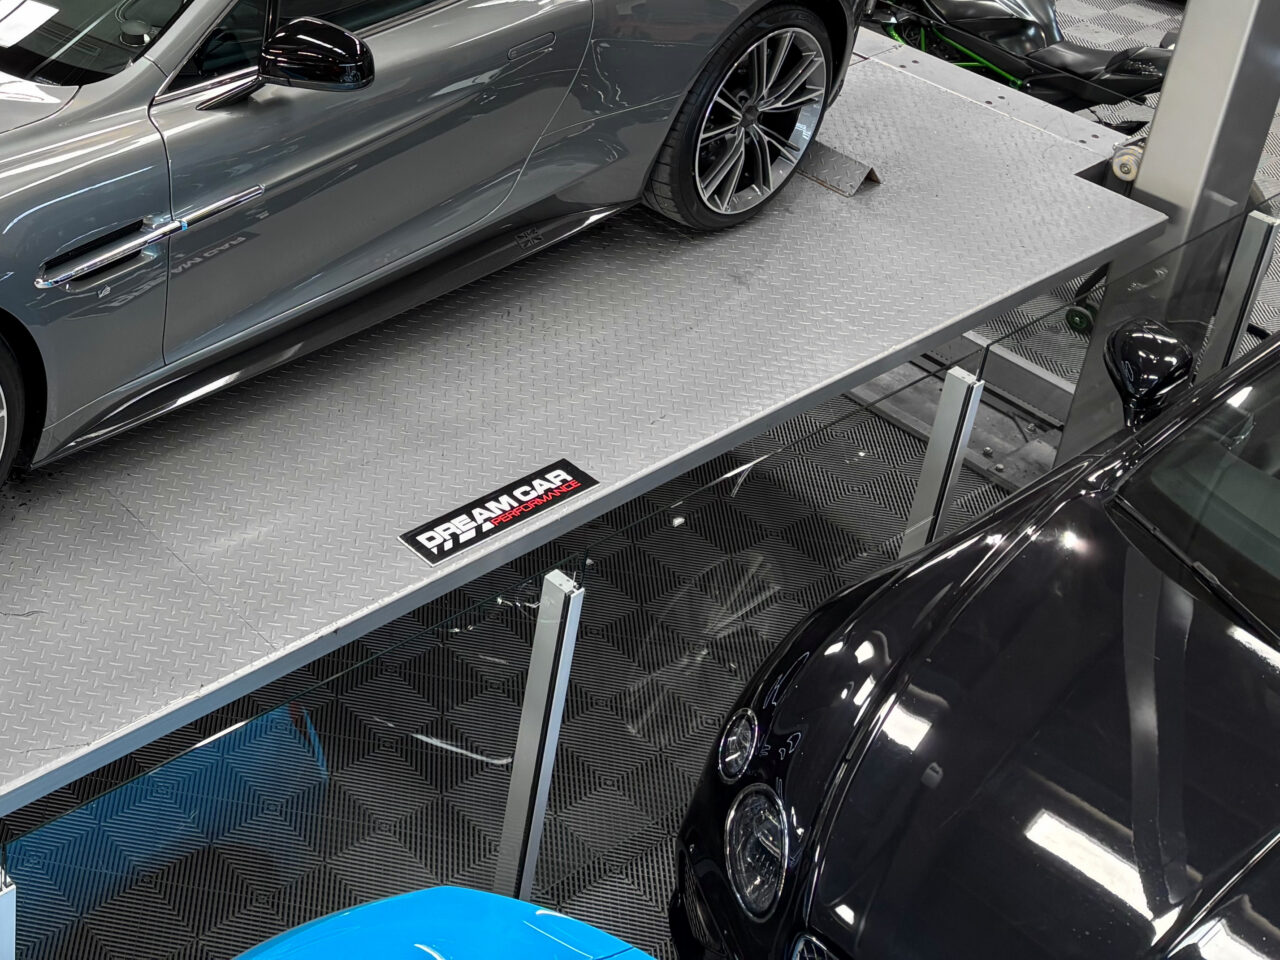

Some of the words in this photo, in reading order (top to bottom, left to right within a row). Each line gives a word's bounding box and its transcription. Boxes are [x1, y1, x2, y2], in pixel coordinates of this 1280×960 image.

[416, 495, 517, 552] DREAM
[512, 469, 574, 503] CAR
[491, 479, 582, 527] PERFORMANCE
